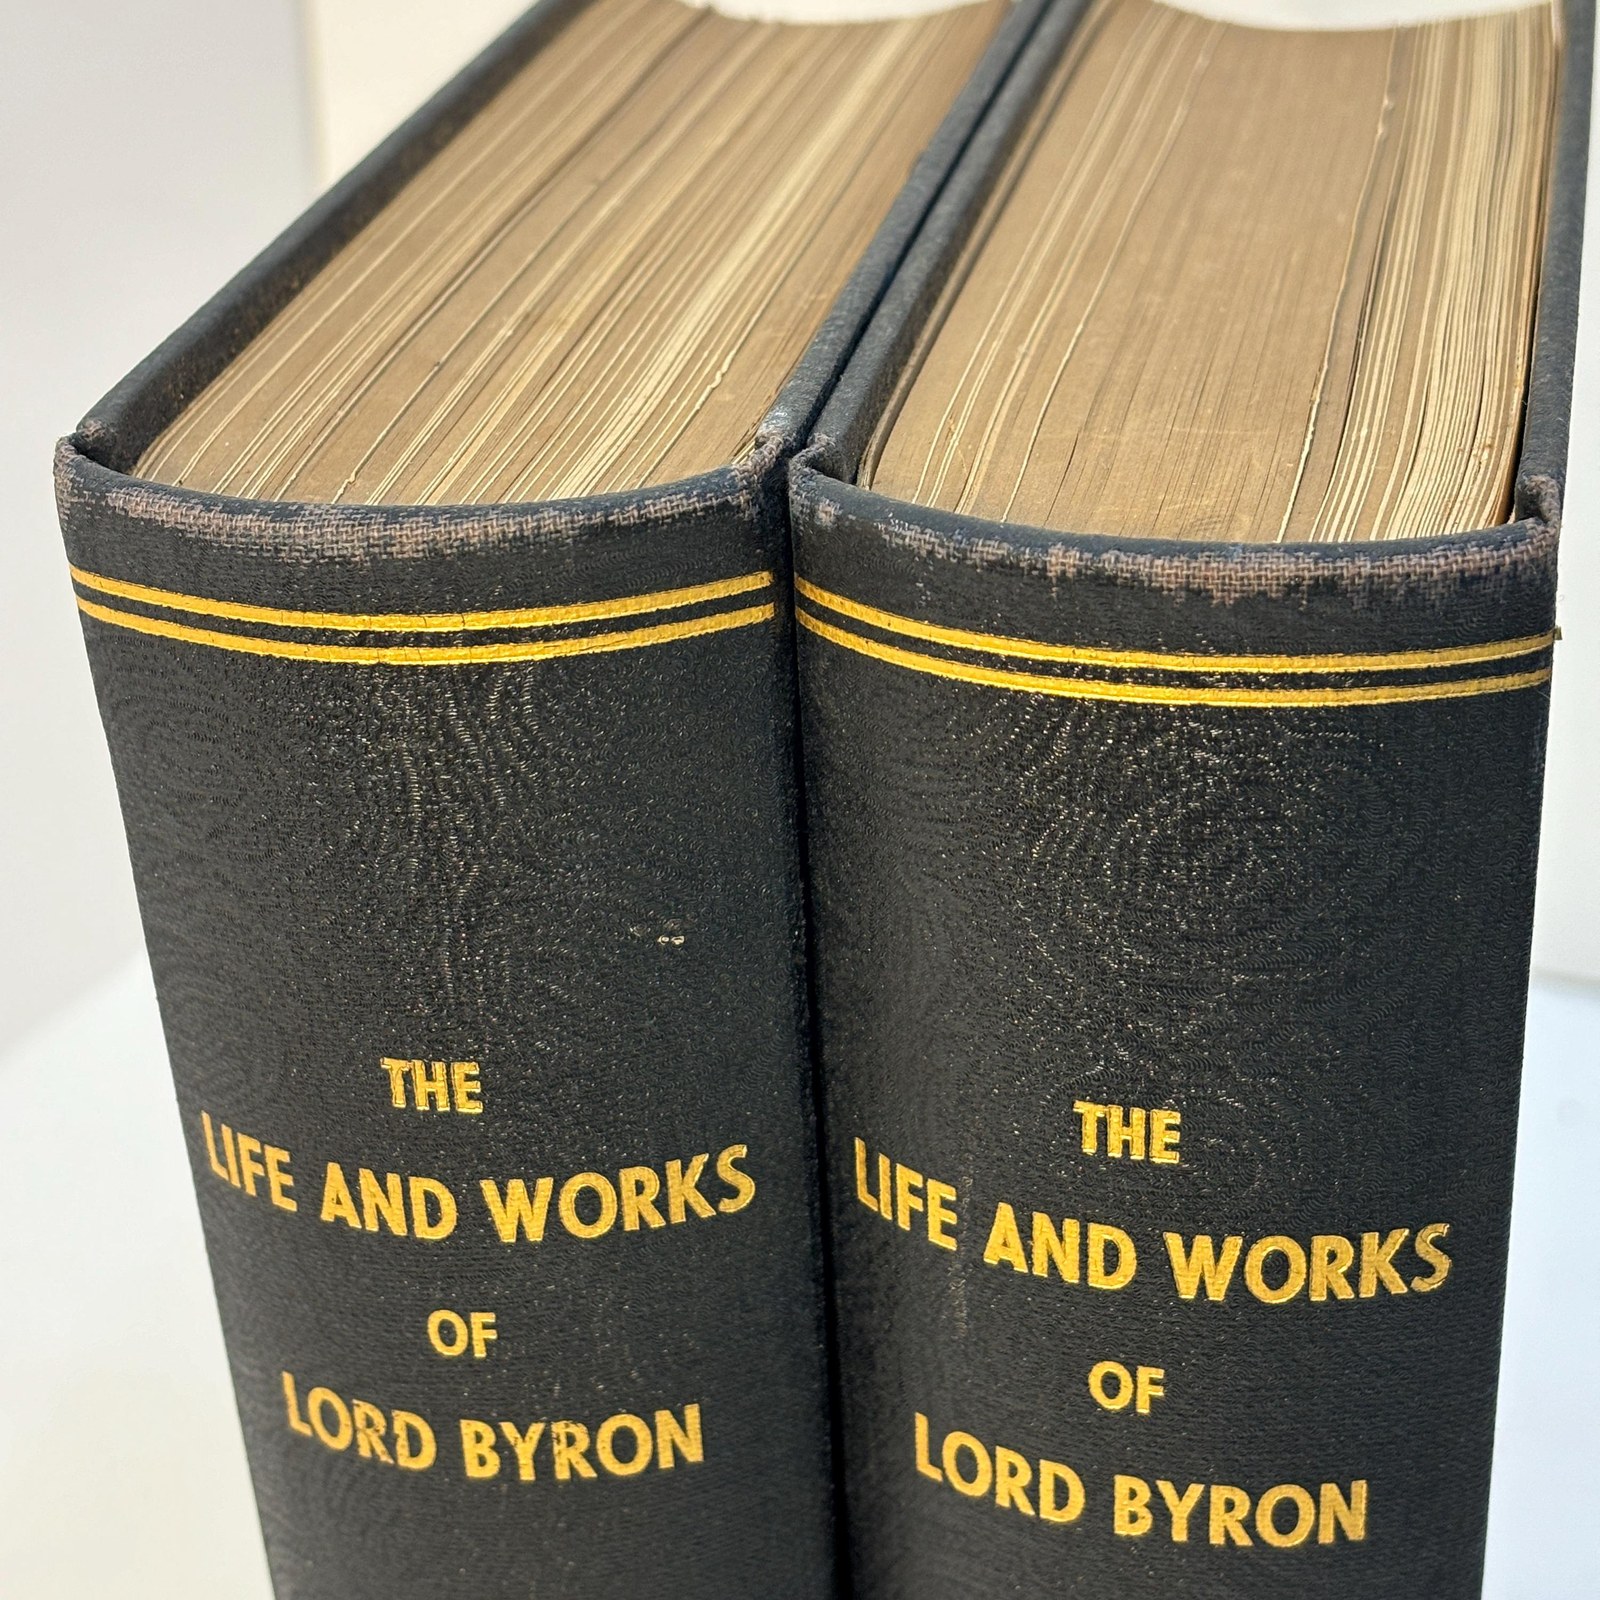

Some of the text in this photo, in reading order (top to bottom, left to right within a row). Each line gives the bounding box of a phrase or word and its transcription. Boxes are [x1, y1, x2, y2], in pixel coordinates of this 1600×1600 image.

[381, 1057, 484, 1115] THE
[1073, 1100, 1182, 1164] THE
[200, 1112, 757, 1244] LIFE AND WORKS
[853, 1137, 1453, 1305] LIFE AND WORKS
[427, 1310, 498, 1359] OF
[281, 1371, 705, 1484] LORD BYRON
[1088, 1360, 1165, 1415] OF
[914, 1412, 1369, 1549] LORD BYRON
